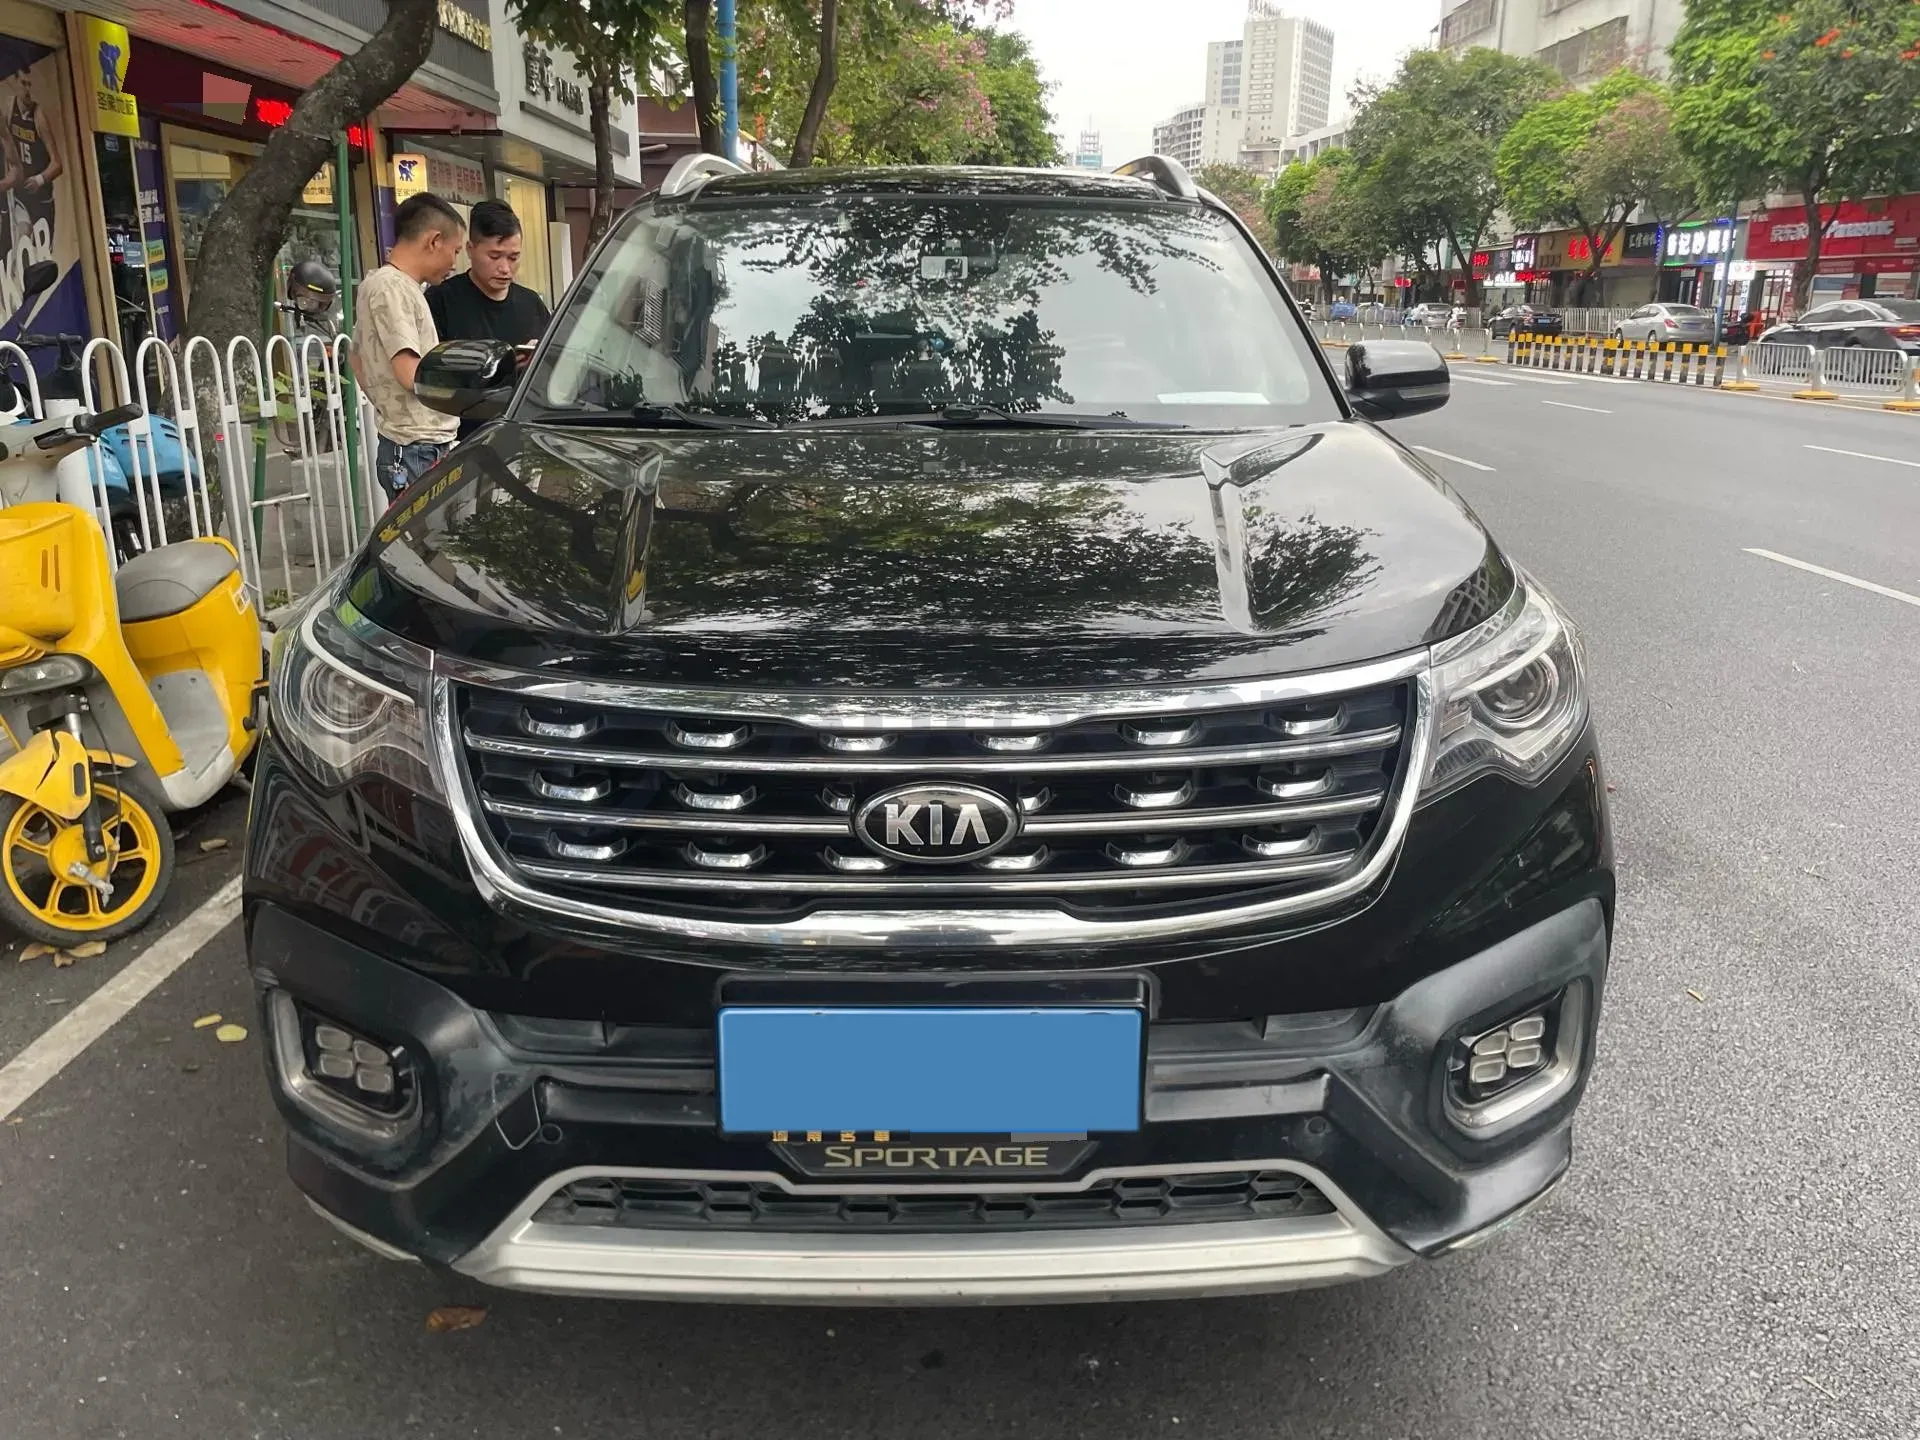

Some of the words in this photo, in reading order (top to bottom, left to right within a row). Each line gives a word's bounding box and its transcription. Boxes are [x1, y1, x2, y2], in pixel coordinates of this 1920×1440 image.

[20, 141, 32, 165] 15
[1825, 216, 1896, 239] Panasonic
[884, 803, 991, 846] KIA
[824, 1145, 1049, 1169] SPORTAGE
